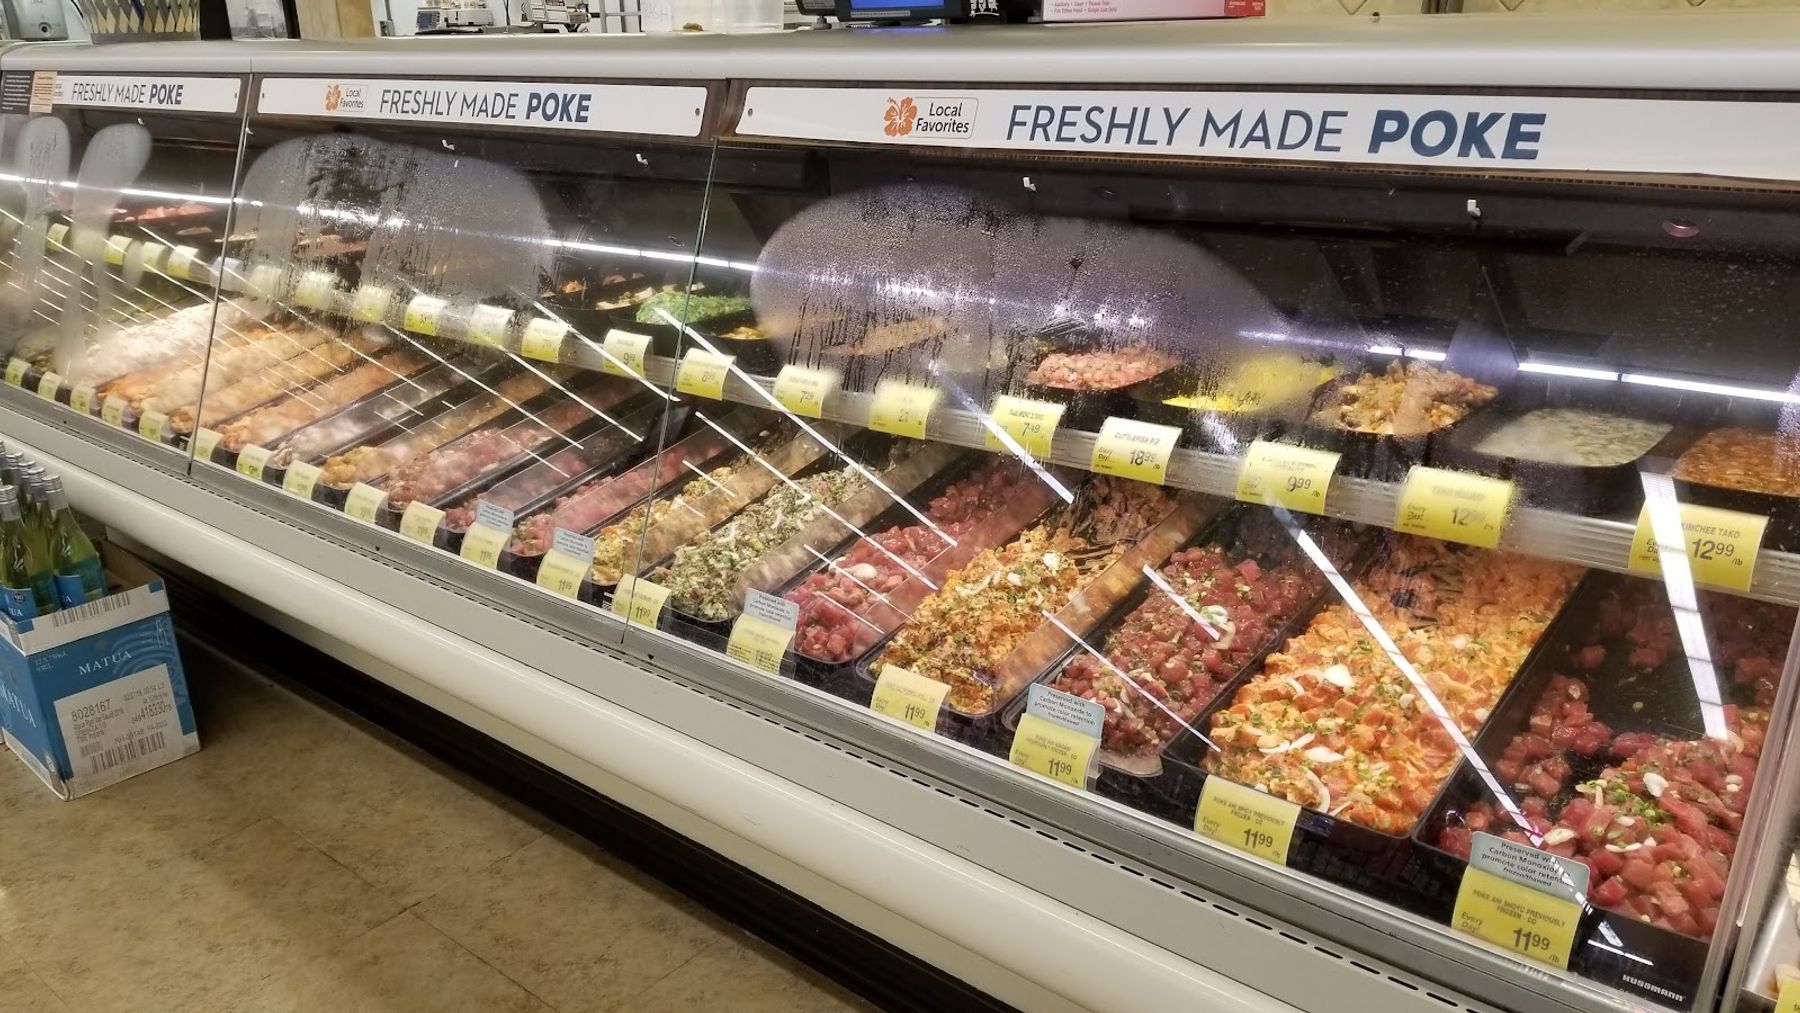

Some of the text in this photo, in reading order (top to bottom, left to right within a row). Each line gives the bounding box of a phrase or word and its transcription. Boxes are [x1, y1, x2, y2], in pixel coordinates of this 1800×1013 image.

[72, 83, 114, 103] FRESHLY
[115, 84, 147, 104] MADE
[149, 84, 184, 105] POKE
[345, 87, 361, 97] Local
[340, 98, 364, 109] Favorites
[380, 89, 592, 122] FRESHLY MADE POKE
[929, 102, 962, 118] Local
[915, 118, 969, 134] Favorites
[1006, 104, 1547, 160] FRESHLY MADE POKE
[1719, 528, 1740, 539] TAKO
[79, 650, 132, 676] MATUA
[1040, 696, 1057, 705] Carbon
[1059, 702, 1085, 714] Monoxide
[1048, 691, 1072, 703] Preserved
[71, 698, 111, 721] 8028167
[1231, 809, 1251, 821] FROZEN
[1489, 847, 1517, 861] Carbon
[1501, 841, 1539, 860] Preserved
[1481, 854, 1515, 868] promote
[1517, 863, 1536, 875] color
[1503, 867, 1552, 887] frozen/thawed
[1473, 889, 1565, 928] POKE AHI SHOYU PREVIOUSLY
[1497, 906, 1536, 925] FROZEN CO
[1461, 911, 1483, 926] Every
[1461, 921, 1476, 933] Day
[1549, 954, 1560, 963] /lb
